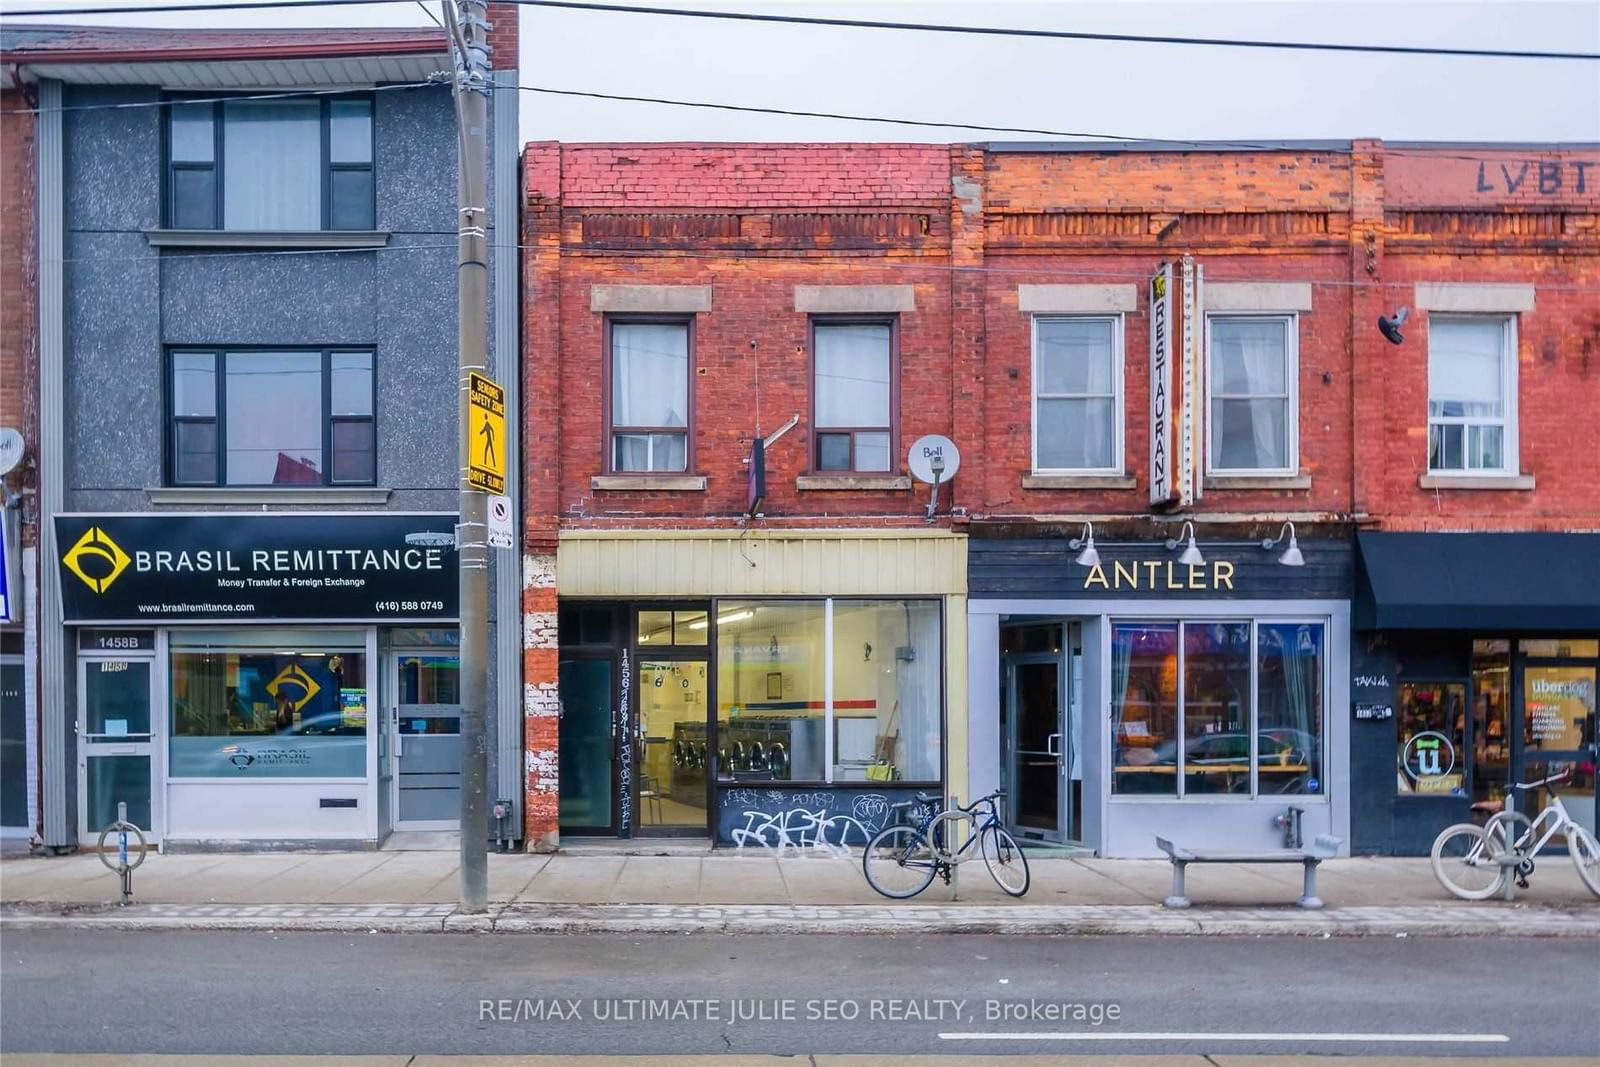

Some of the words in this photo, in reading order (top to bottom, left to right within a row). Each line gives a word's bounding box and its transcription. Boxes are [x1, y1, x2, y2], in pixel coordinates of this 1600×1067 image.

[1155, 302, 1165, 496] RESTAURANT
[923, 446, 943, 458] Bell
[135, 550, 240, 572] BRASIL
[252, 549, 443, 571] REMITTANCE
[1083, 560, 1234, 590] ANTLER
[218, 578, 245, 588] Money
[246, 577, 281, 587] Transfer
[283, 577, 290, 586] &
[292, 577, 323, 588] Foreign
[325, 576, 365, 587] Exchange
[138, 602, 255, 613] www.brasilremittance.com
[375, 600, 400, 612] (416)
[401, 600, 419, 611] 588
[420, 600, 444, 611] 0749
[99, 637, 139, 648] 1458B
